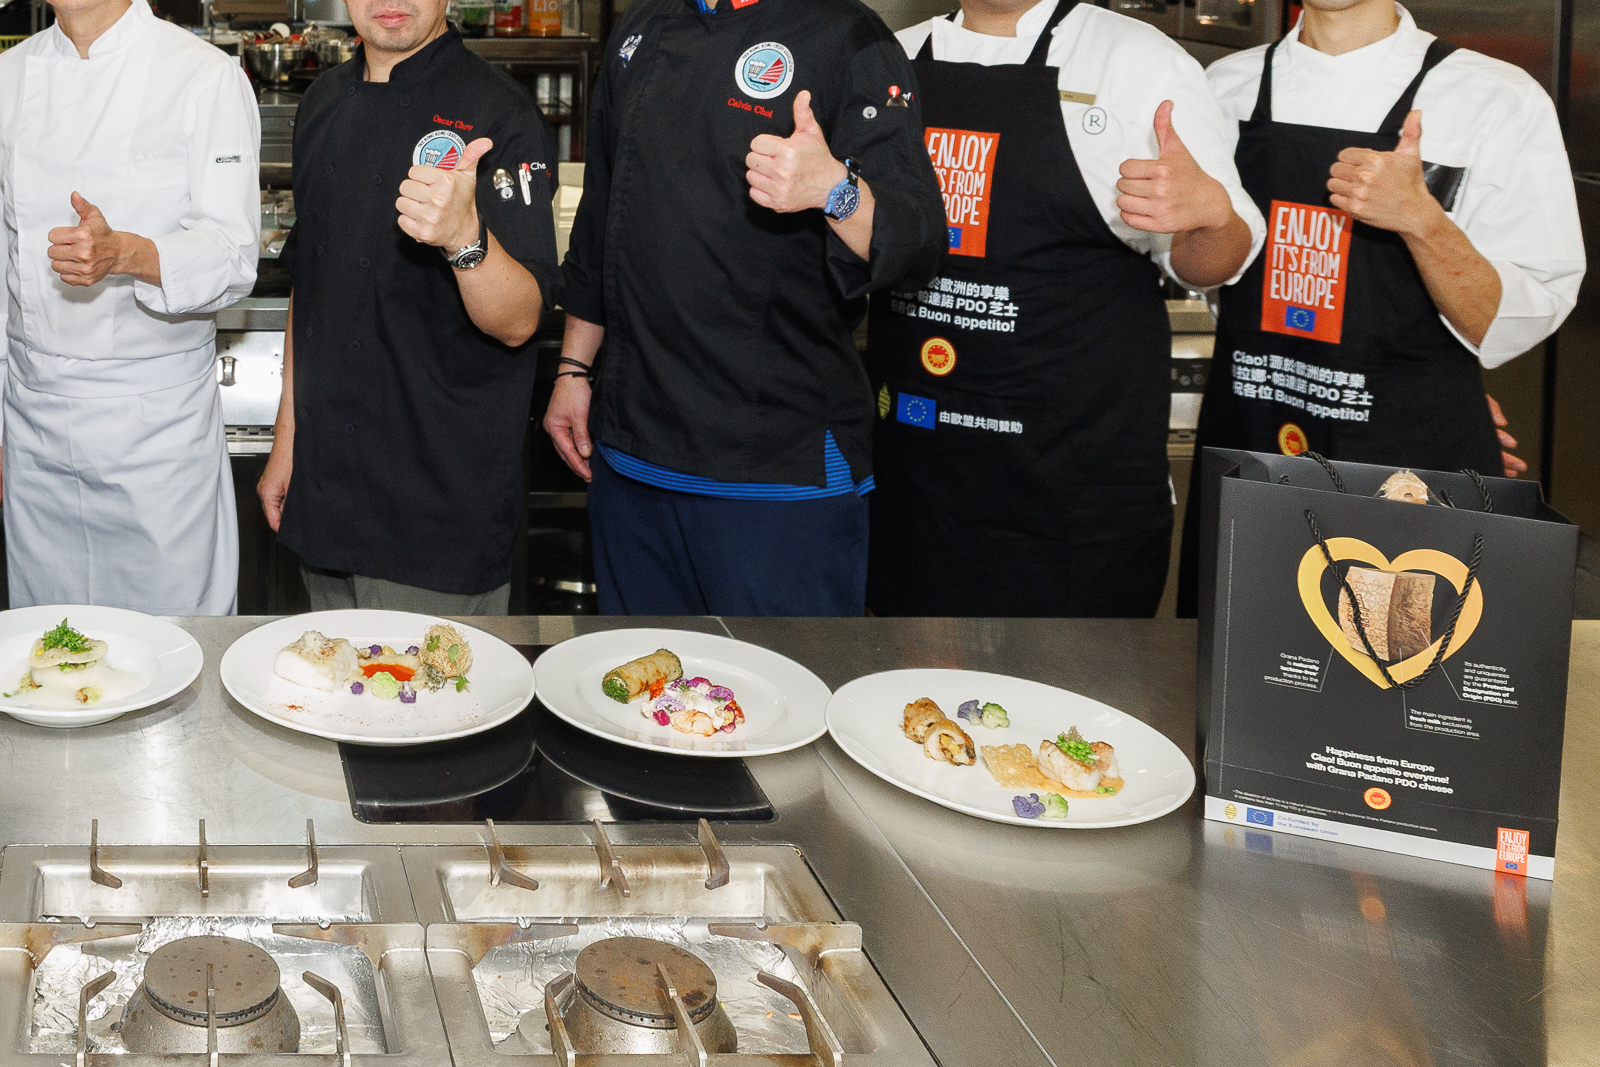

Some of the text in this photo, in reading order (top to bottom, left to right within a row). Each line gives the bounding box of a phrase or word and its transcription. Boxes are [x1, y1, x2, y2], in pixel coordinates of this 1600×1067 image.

[1089, 114, 1102, 127] R
[928, 132, 993, 172] ENJOY
[948, 169, 986, 196] FROM
[1274, 206, 1346, 253] ENJOY
[1272, 243, 1341, 279] IT'S FROM
[1270, 268, 1338, 310] EUROPE
[918, 306, 952, 323] Buon
[953, 315, 1016, 332] appetito!
[955, 297, 1019, 317] PDO 芝士
[1232, 350, 1268, 367] Ciao!
[1275, 389, 1305, 409] Buon
[1306, 402, 1370, 422] appetito!
[1308, 383, 1340, 401] PDO
[1340, 389, 1374, 406] 芝士
[1462, 686, 1501, 697] Designation
[1462, 692, 1483, 701] Origin
[1483, 683, 1515, 692] Protected
[1310, 752, 1449, 784] Ciao! Buon appetito everyone!
[1326, 746, 1435, 773] Happiness from Europe
[1306, 761, 1454, 794] with Grana Padano PDO cheese
[1500, 830, 1527, 846] ENJOY
[1499, 850, 1525, 863] EUROPE
